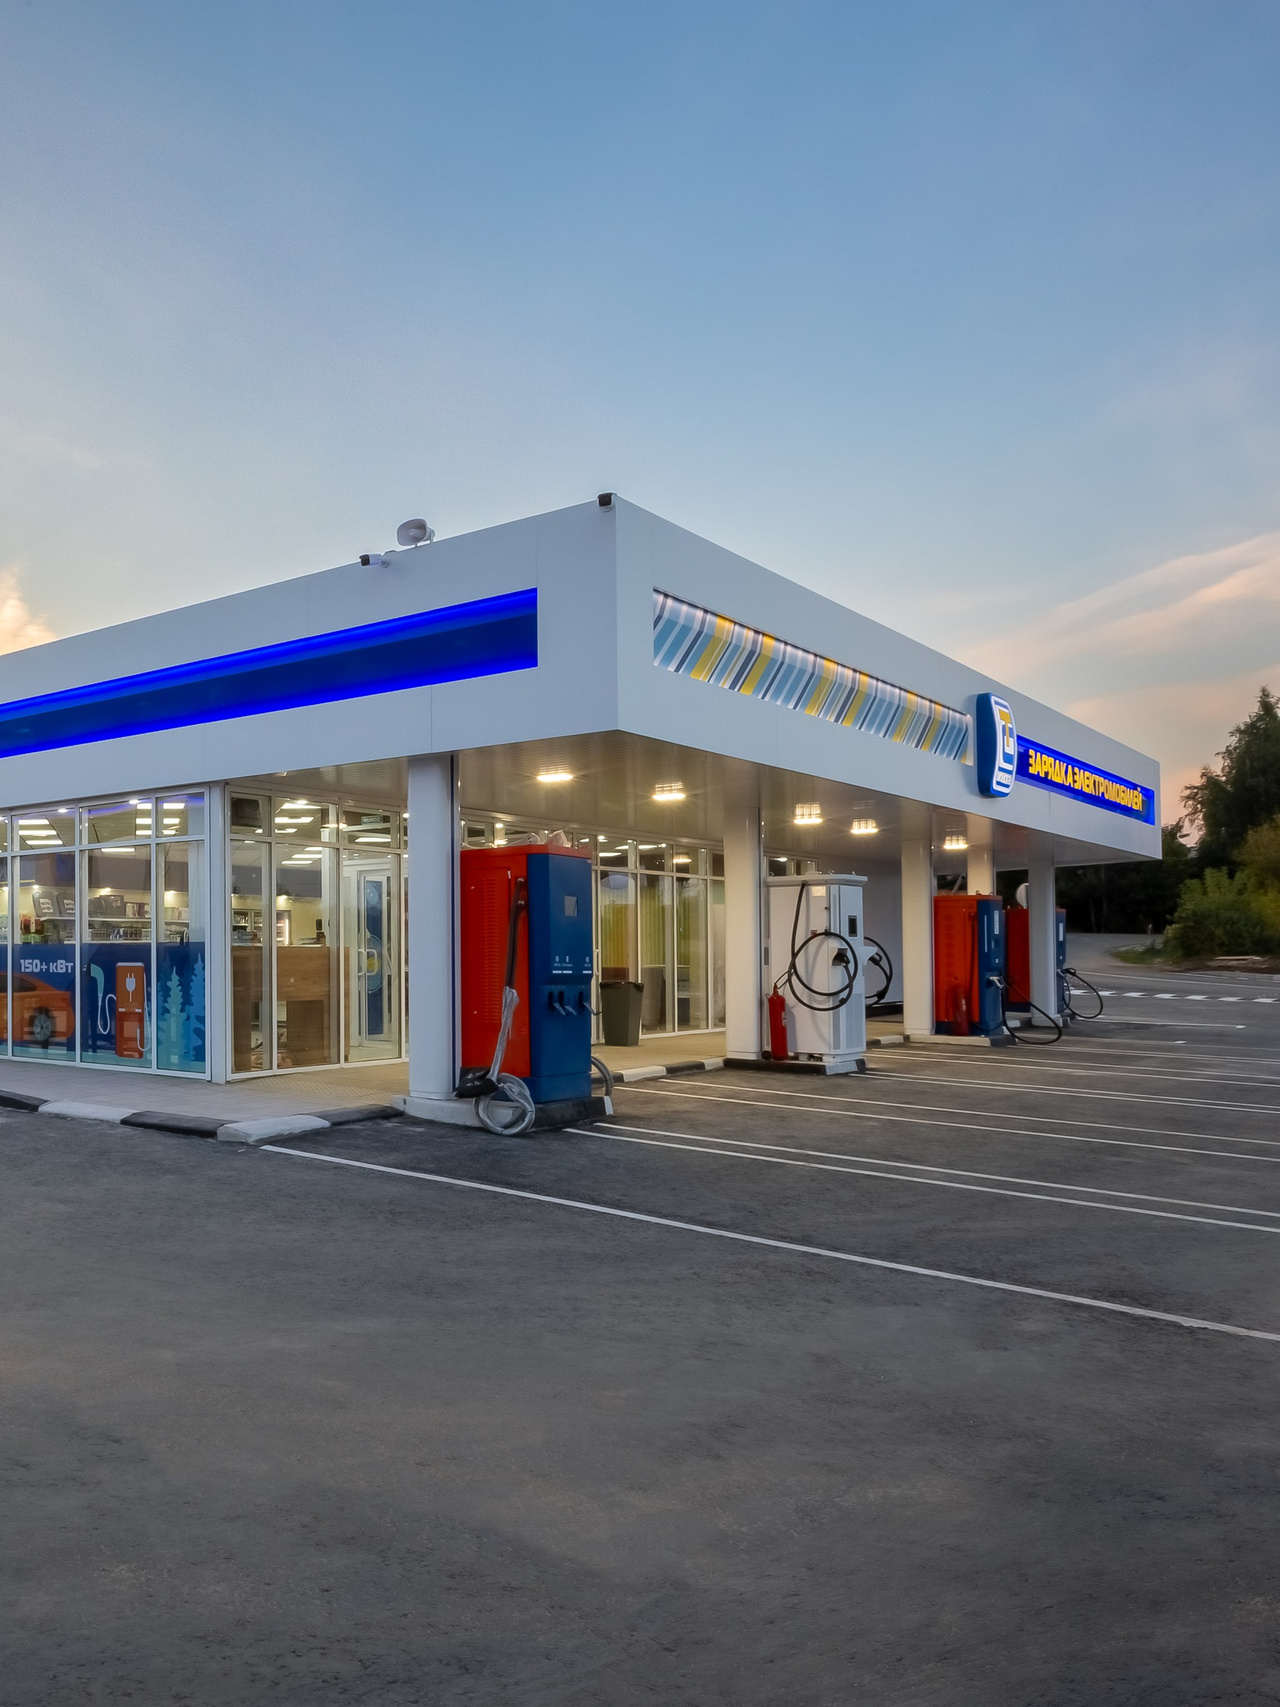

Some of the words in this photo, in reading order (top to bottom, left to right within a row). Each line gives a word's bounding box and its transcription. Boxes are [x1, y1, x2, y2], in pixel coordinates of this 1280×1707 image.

[1028, 749, 1074, 788] ЗАРЯДКА
[1073, 766, 1143, 811] ЭЛЕКТРОМОБИЛЕЙ
[20, 959, 48, 973] 150+
